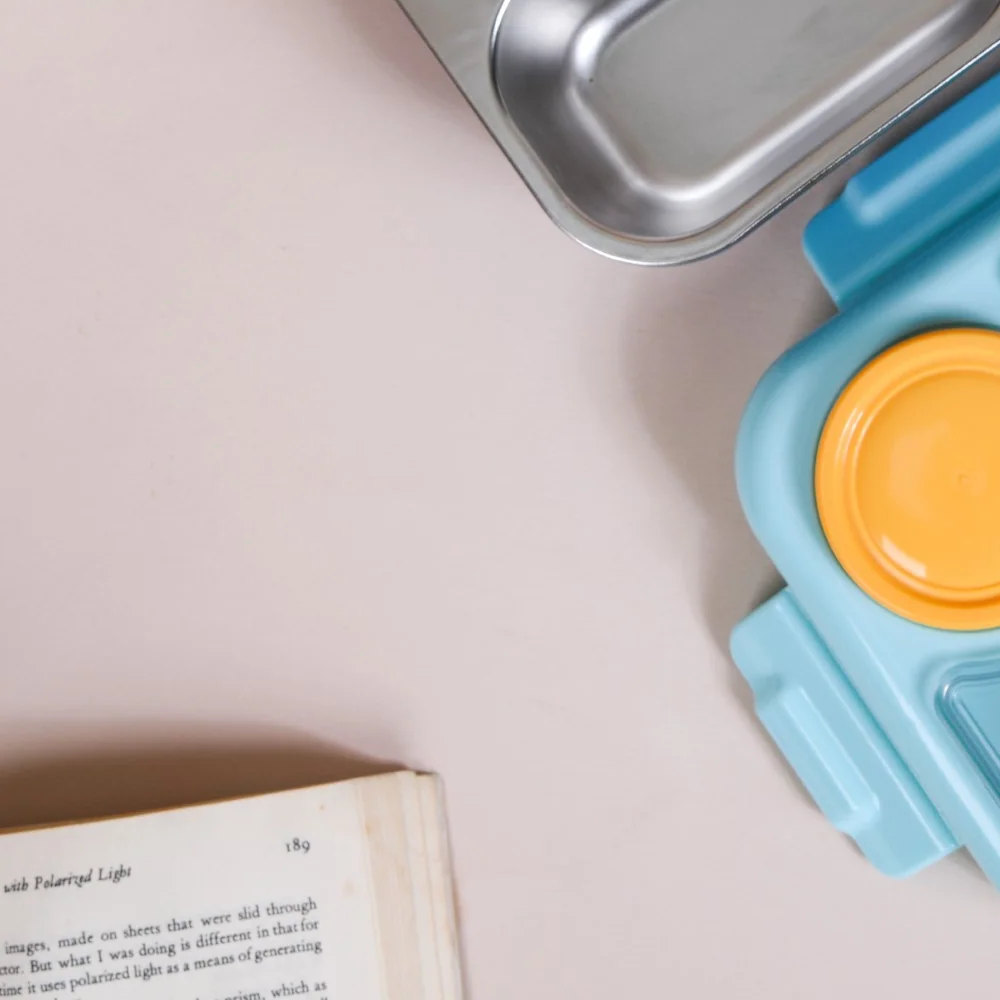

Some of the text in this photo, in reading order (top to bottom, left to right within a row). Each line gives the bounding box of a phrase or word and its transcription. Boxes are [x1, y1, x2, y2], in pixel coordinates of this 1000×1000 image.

[285, 838, 312, 854] 189
[3, 863, 132, 894] with Polarized Light
[4, 896, 317, 957] images, made on sheets that were slid through
[29, 959, 53, 974] But
[58, 953, 91, 969] what
[97, 949, 104, 963] I
[109, 950, 134, 961] was
[138, 942, 177, 958] doing
[180, 938, 192, 952] is
[195, 930, 252, 949] different
[256, 925, 270, 939] in
[272, 921, 298, 936] that
[300, 917, 319, 933] for
[27, 981, 37, 995] it
[39, 981, 67, 993] uses
[69, 965, 131, 993] polarized
[133, 962, 163, 981] light
[166, 965, 180, 974] as
[183, 963, 190, 972] a
[194, 953, 236, 971] means
[238, 946, 253, 962] of
[253, 939, 323, 964] generating
[270, 980, 310, 998] which
[313, 982, 328, 993] as
